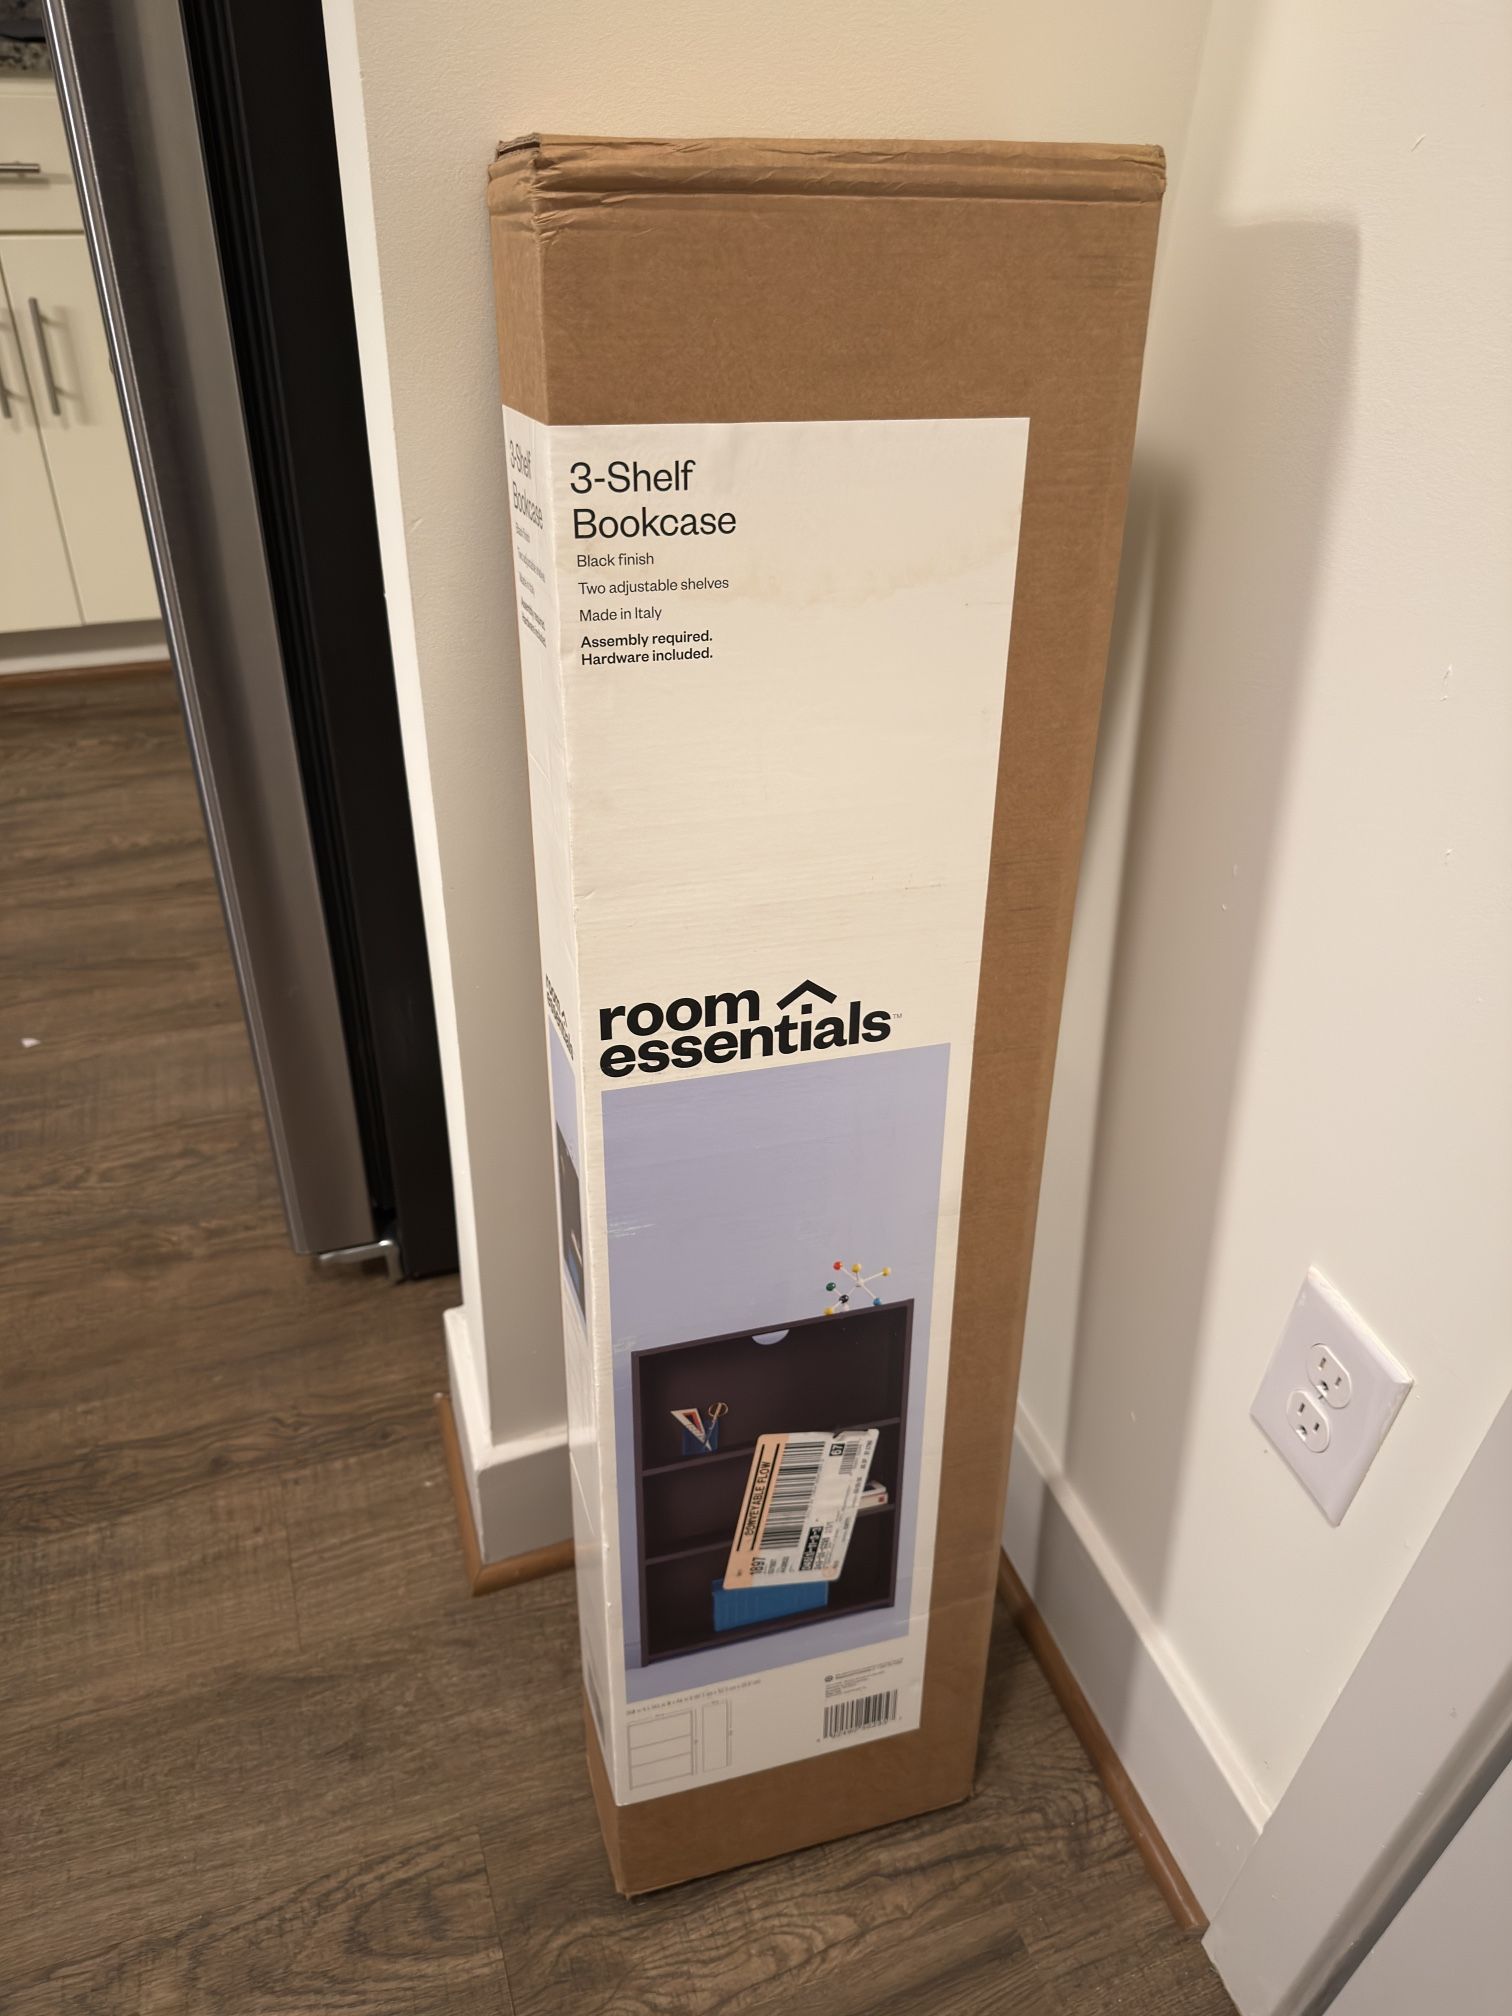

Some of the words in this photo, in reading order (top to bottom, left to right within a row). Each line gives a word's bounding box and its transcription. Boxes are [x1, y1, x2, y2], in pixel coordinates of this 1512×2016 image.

[570, 459, 696, 494] 3-Shelf
[573, 507, 737, 539] Bookcase
[577, 554, 615, 567] Black
[618, 552, 654, 566] finish
[578, 582, 606, 595] Two
[609, 578, 678, 596] adjustable
[680, 577, 729, 590] shelves
[579, 608, 617, 622] Made
[620, 607, 632, 620] in
[635, 606, 662, 621] Italy
[580, 633, 649, 648] Assembly
[652, 630, 713, 646] required.
[581, 652, 650, 665] Hardware
[652, 647, 713, 661] included.
[599, 989, 760, 1041] room
[600, 1001, 892, 1078] essentials
[757, 1461, 771, 1484] FLOW
